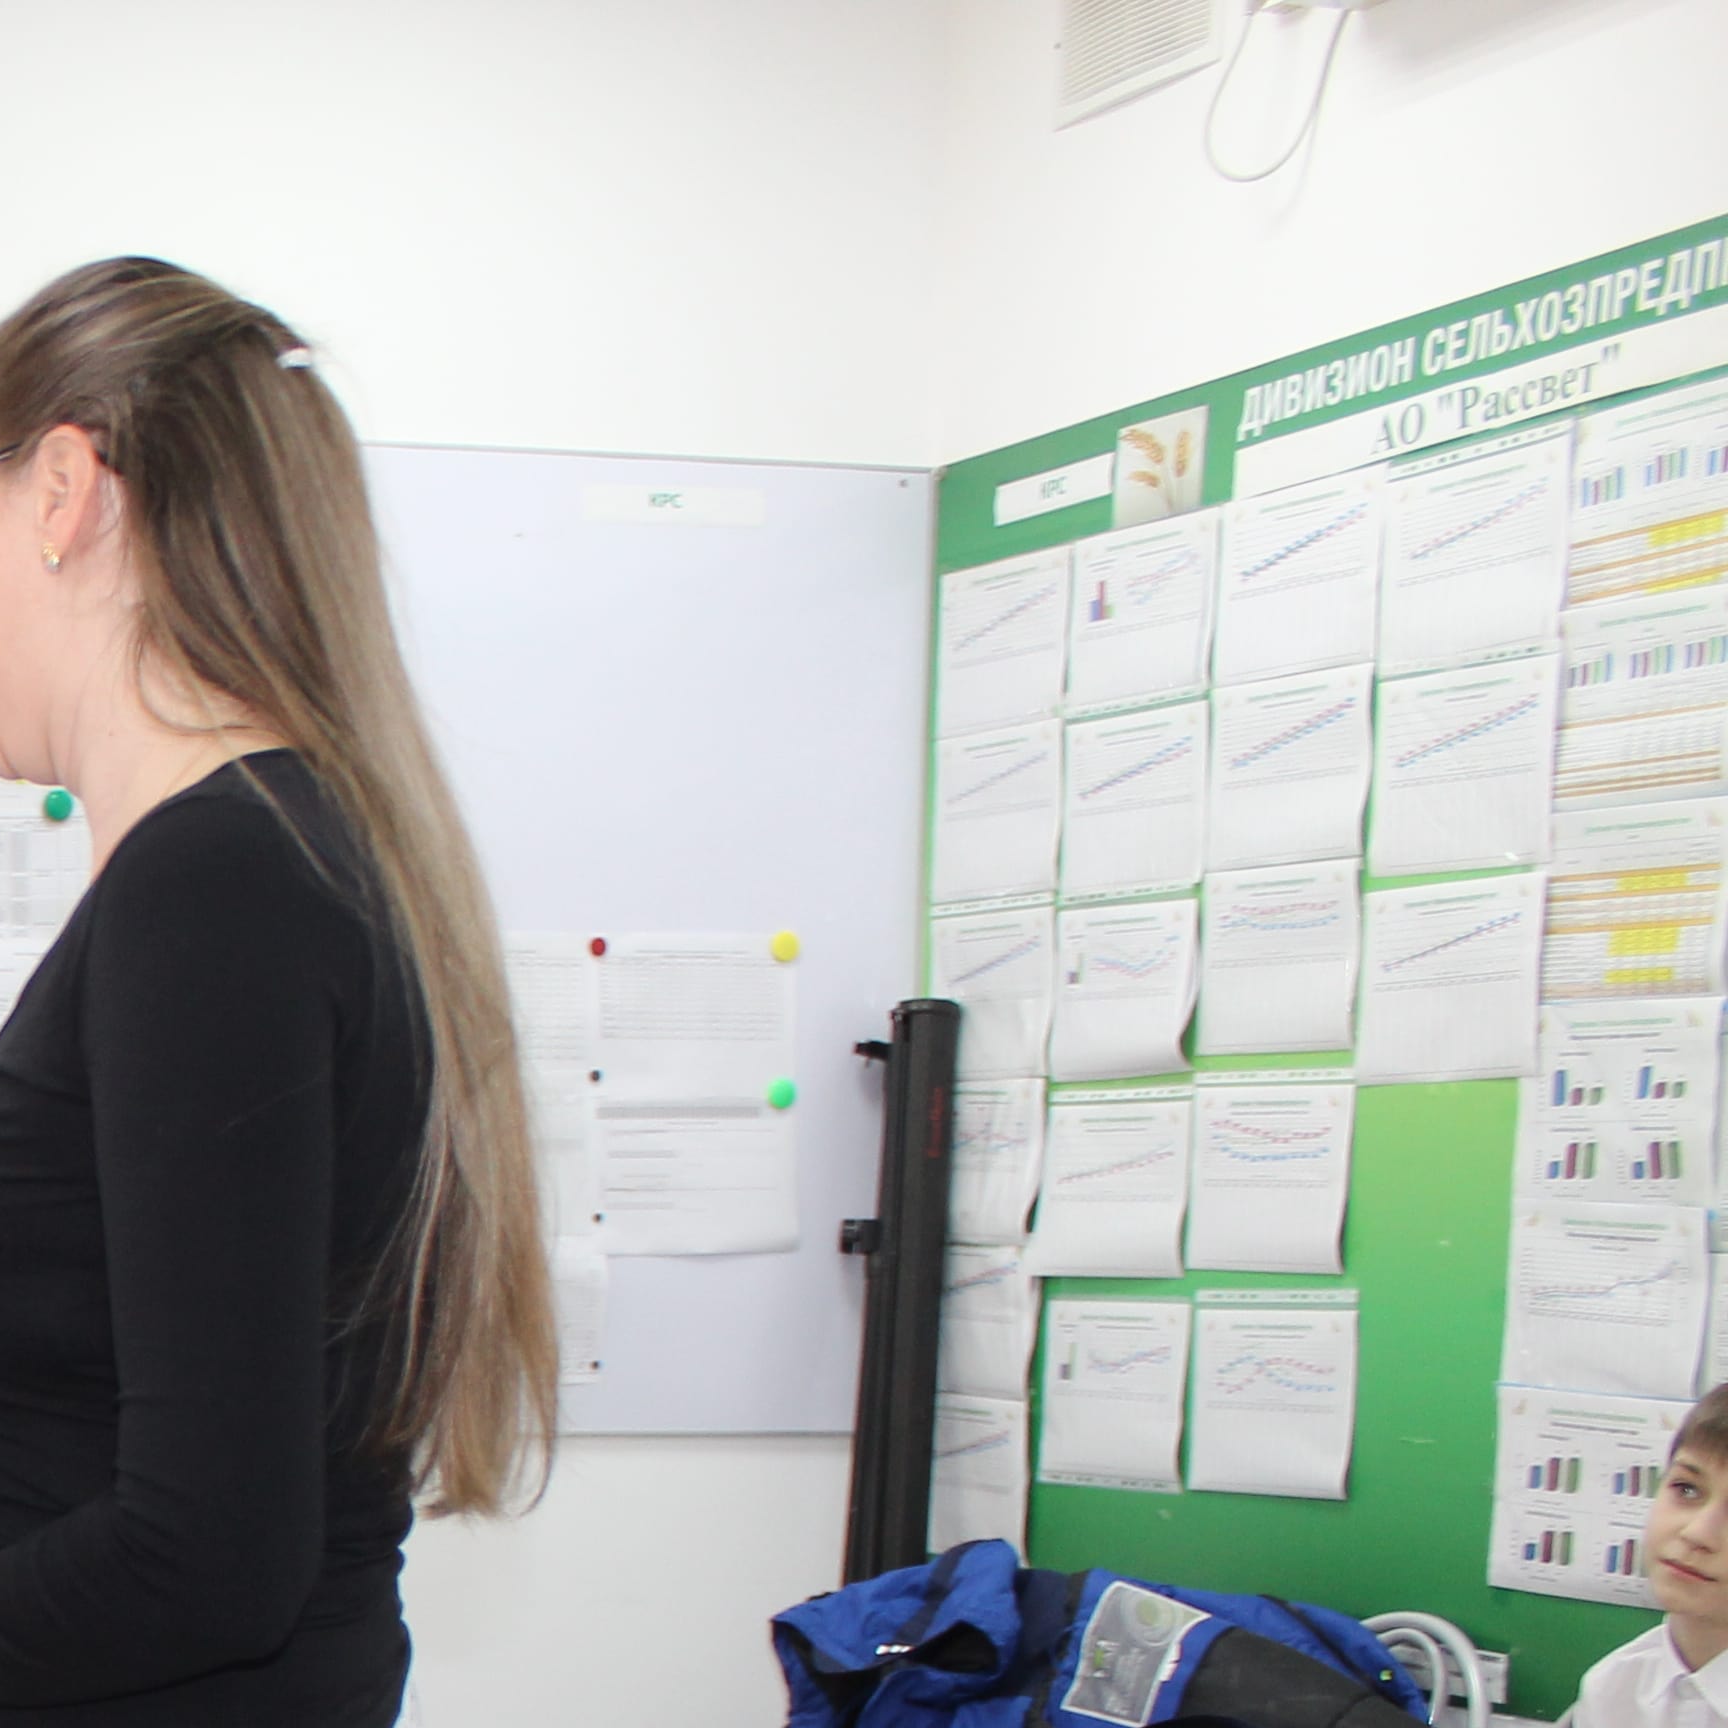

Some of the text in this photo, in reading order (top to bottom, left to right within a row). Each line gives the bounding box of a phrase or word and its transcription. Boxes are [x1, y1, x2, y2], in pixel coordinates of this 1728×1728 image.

[1237, 337, 1416, 441] ДИВИЗИОН
[1370, 404, 1426, 455] АО
[1436, 342, 1622, 429] "Рассвет"
